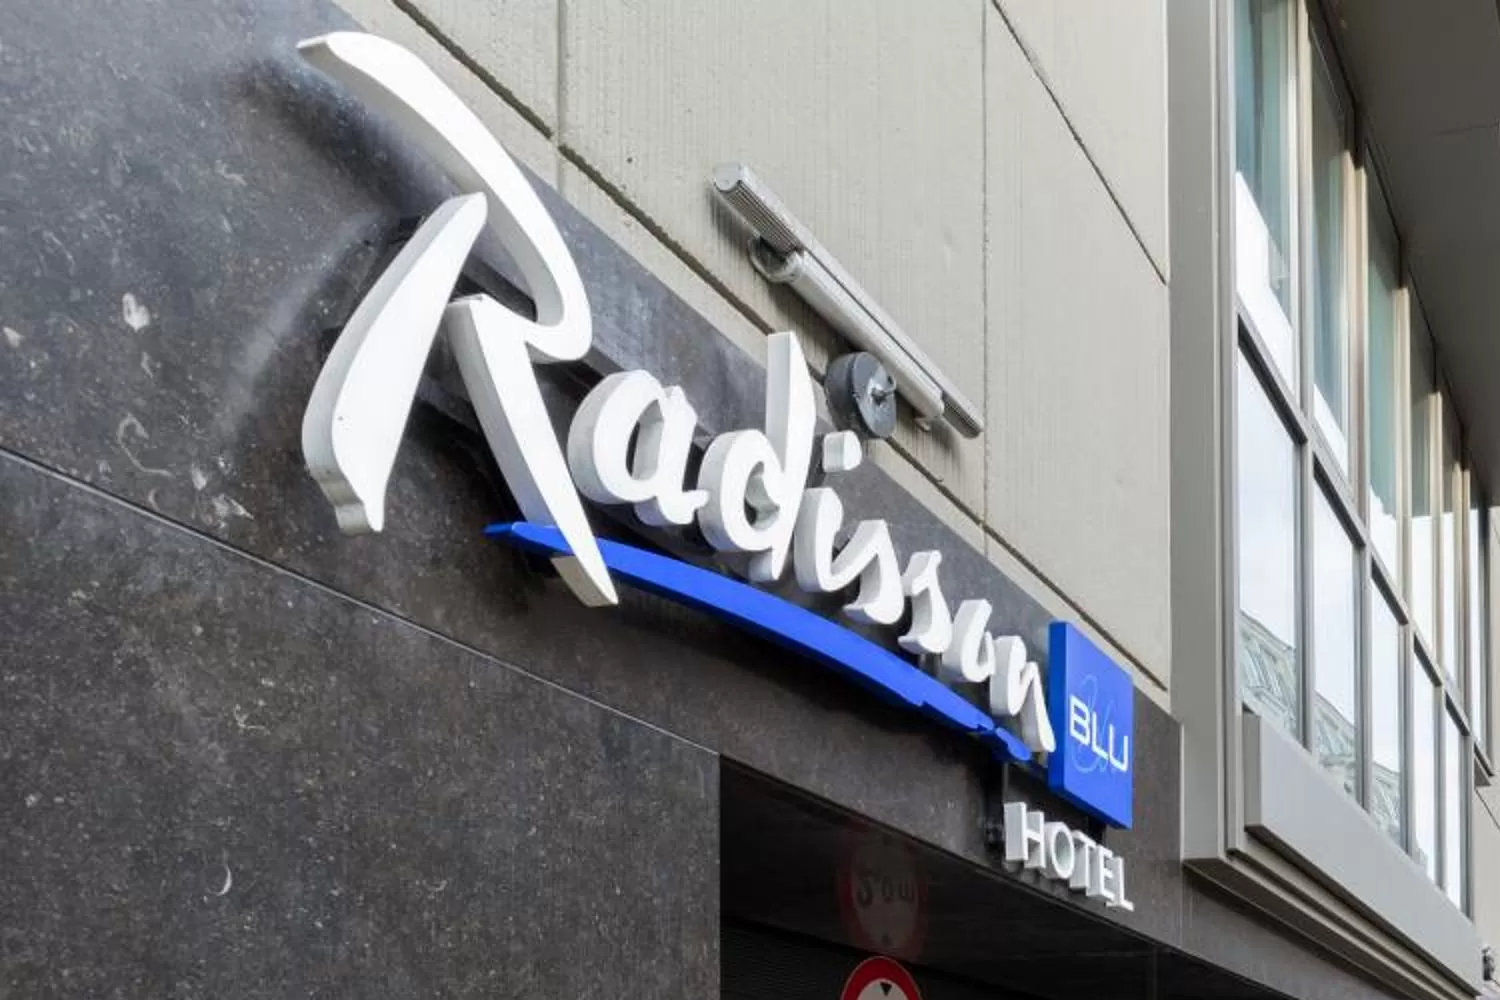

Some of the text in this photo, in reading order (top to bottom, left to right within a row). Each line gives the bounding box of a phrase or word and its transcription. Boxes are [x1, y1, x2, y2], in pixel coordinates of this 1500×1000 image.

[297, 31, 1129, 772] Radisson BLU
[1003, 801, 1134, 912] HOTEL
